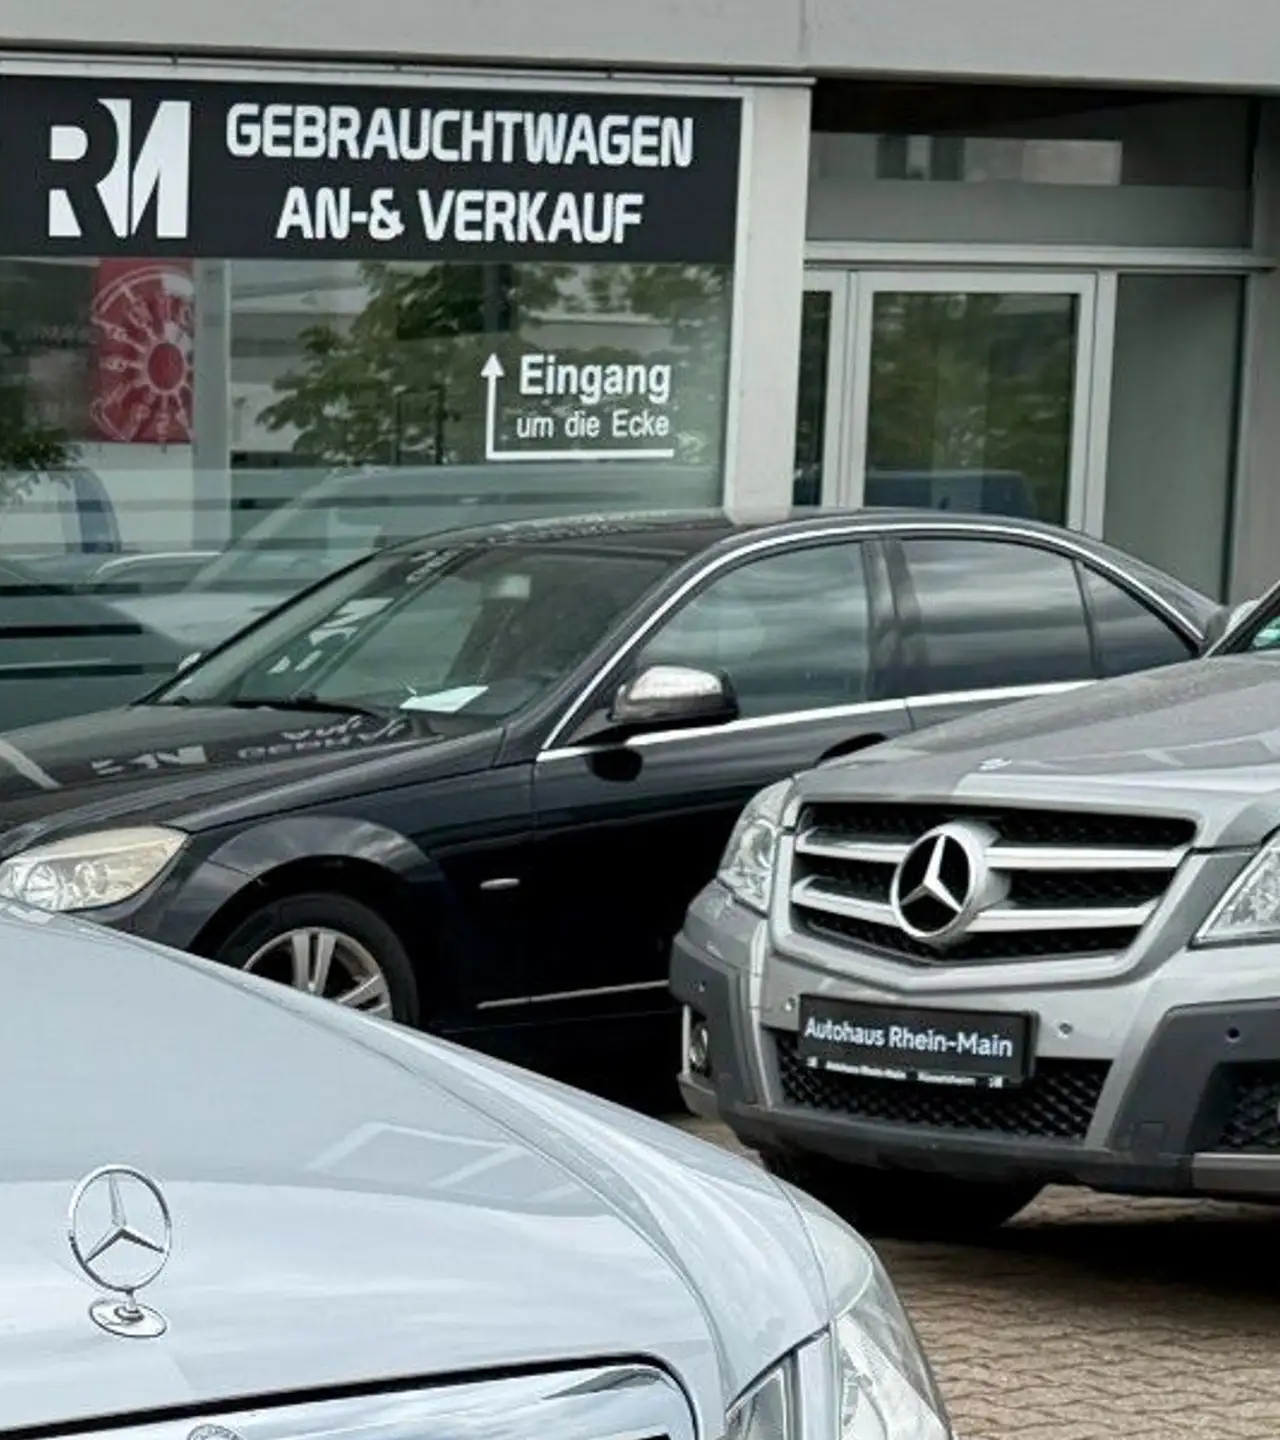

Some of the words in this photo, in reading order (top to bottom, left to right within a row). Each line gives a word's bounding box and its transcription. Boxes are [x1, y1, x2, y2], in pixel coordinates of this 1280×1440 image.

[226, 103, 693, 168] GEBRAUCHTWAGEN
[275, 186, 405, 241] AN-&
[417, 189, 644, 244] VERKAUF
[520, 354, 671, 404] Eingang
[516, 416, 554, 438] um
[564, 410, 600, 438] die
[612, 408, 670, 438] Ecke
[804, 1017, 886, 1047] Autohaus
[889, 1026, 1014, 1058] Rhein-Main
